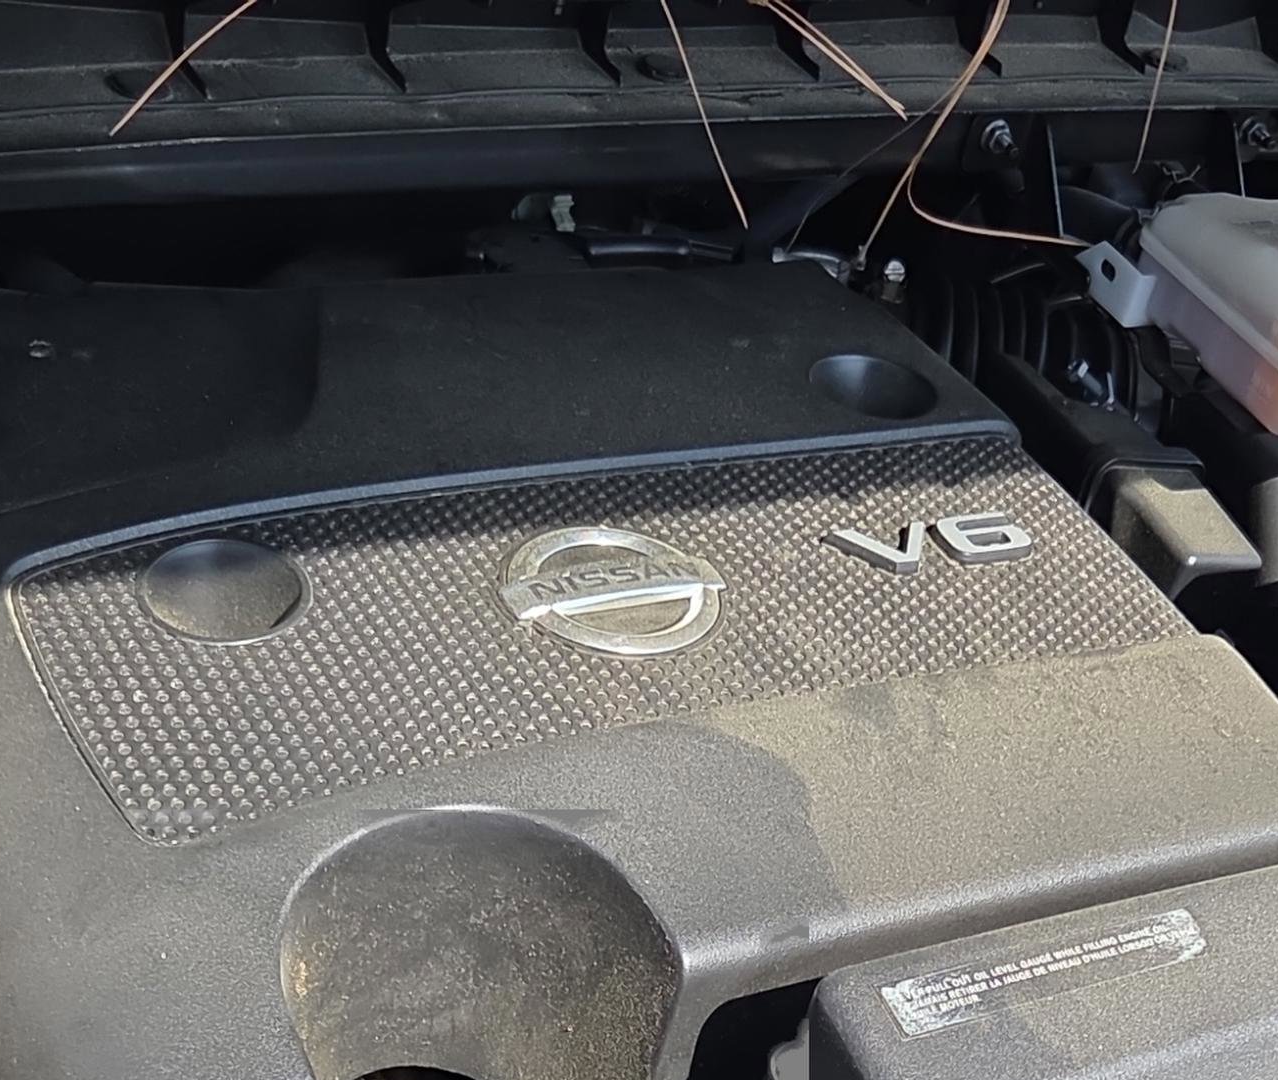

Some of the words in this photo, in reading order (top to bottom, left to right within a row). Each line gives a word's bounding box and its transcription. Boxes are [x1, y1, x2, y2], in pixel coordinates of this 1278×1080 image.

[824, 511, 1032, 572] V6
[528, 562, 701, 600] NISSAN
[990, 962, 1020, 977] LEVEL
[1020, 953, 1053, 969] GAUGE
[1053, 945, 1083, 960] WHILE
[1083, 936, 1117, 952] FILLING
[948, 981, 989, 999] RETIRER
[989, 979, 1002, 989] LA
[1032, 967, 1048, 977] DE
[1047, 958, 1082, 973] NIVEAU
